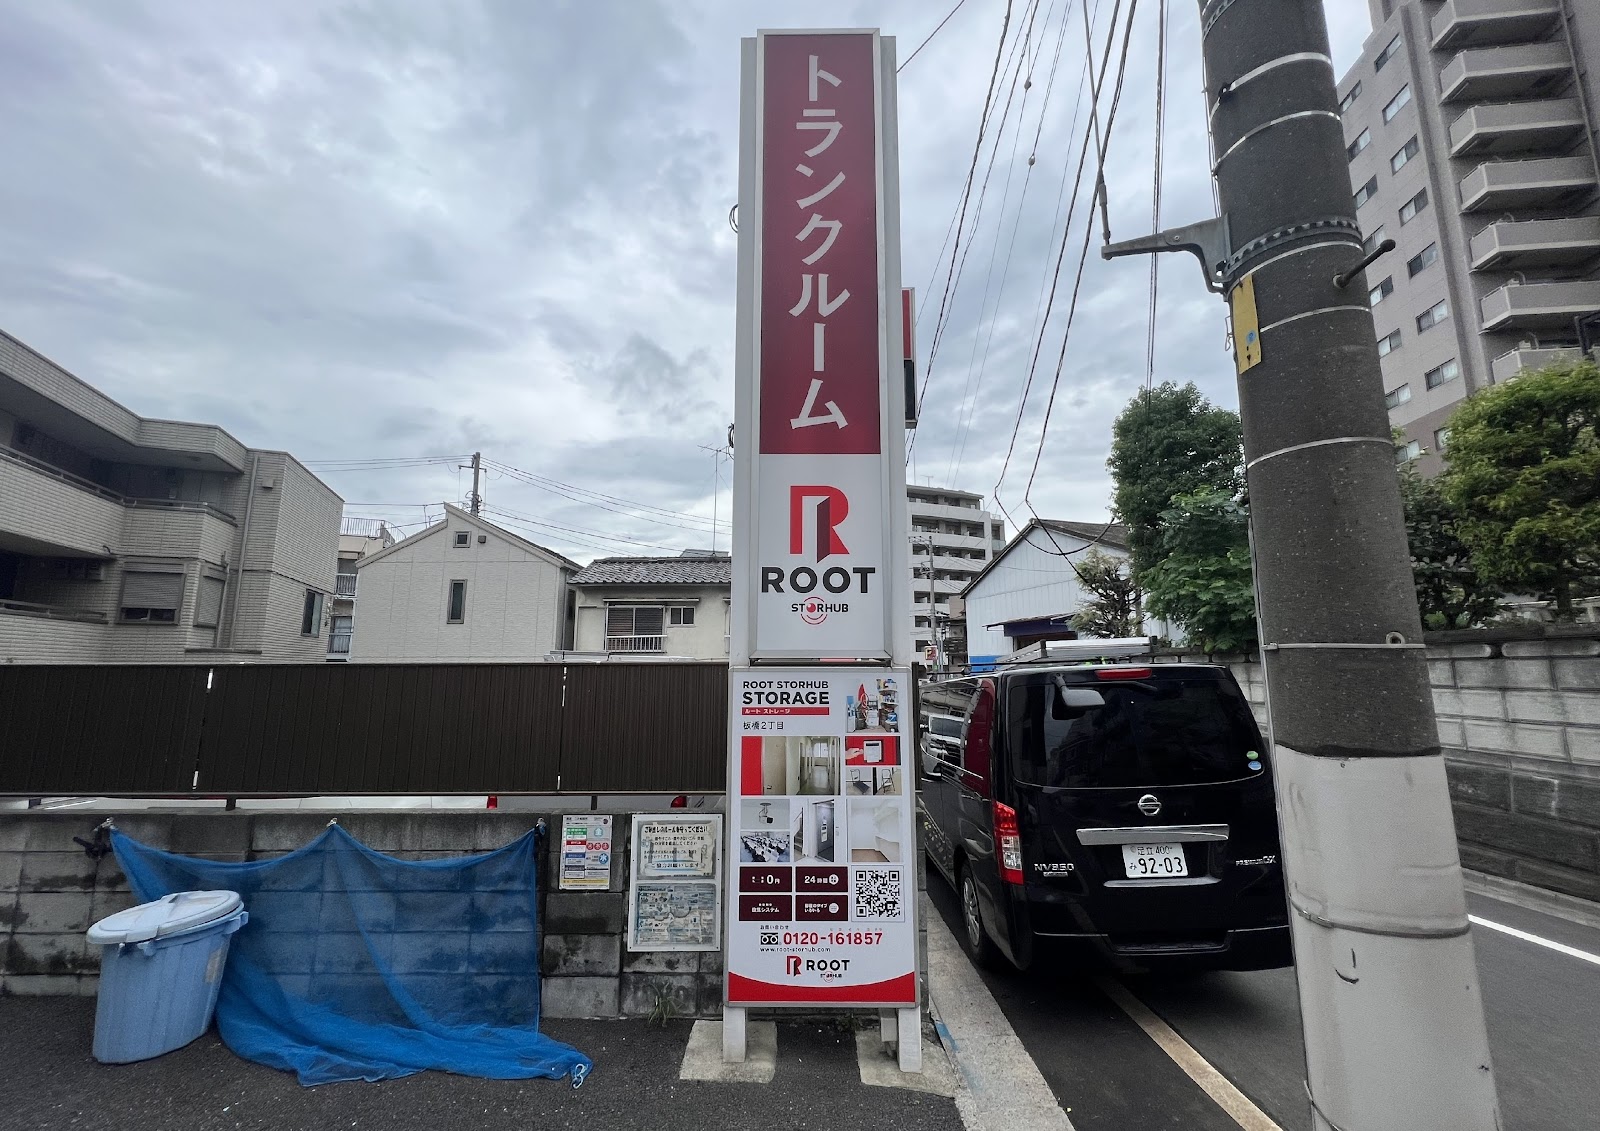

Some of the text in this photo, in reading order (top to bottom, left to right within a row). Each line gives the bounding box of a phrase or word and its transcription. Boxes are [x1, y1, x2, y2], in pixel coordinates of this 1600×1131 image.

[788, 54, 851, 430] トランクルーム
[761, 566, 876, 594] ROOT
[742, 680, 829, 689] ROOT STORHUB
[742, 691, 830, 705] STORAGE
[1137, 846, 1154, 856] 足立
[1034, 862, 1075, 871] NV350
[1138, 856, 1183, 874] 92-03
[783, 932, 883, 945] 0120-161857
[806, 959, 850, 971] ROOT
